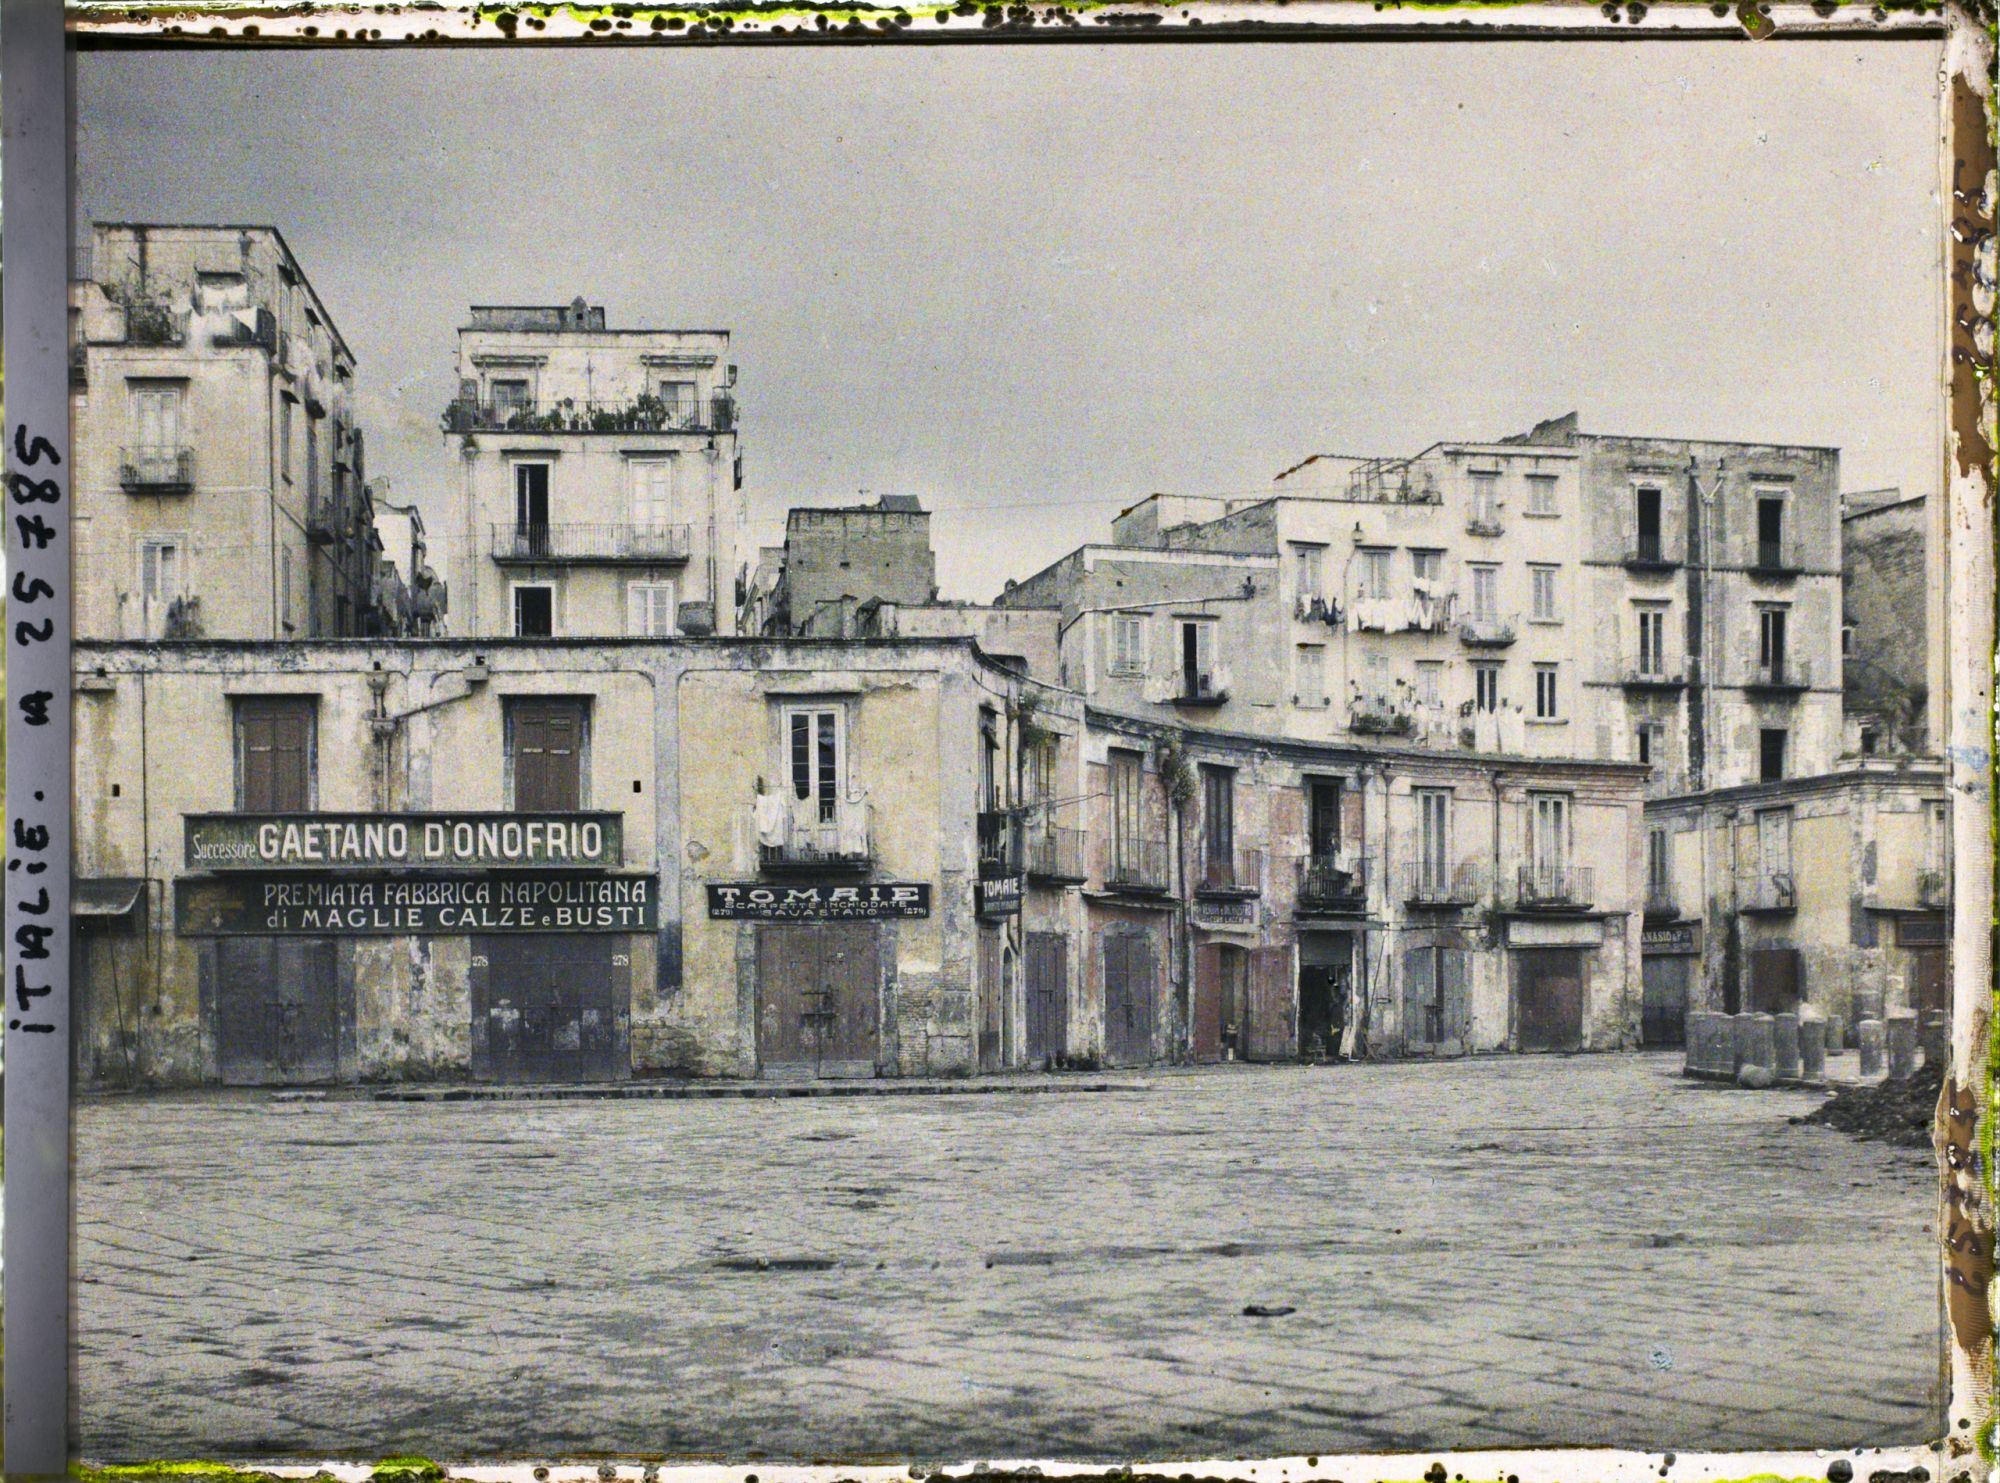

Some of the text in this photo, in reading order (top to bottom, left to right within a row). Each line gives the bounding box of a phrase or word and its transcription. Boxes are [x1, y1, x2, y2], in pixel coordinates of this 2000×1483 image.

[193, 820, 604, 860] Successore GAETANO D'ONOFRIO
[263, 880, 647, 907] PREMIATA FABBRICA NAPOLITANA
[717, 887, 919, 903] TOMAIE
[983, 877, 1019, 897] TOMAIE
[725, 900, 908, 909] SCARPETTE INCHIODATE
[761, 908, 878, 917] SAVASTANO
[266, 907, 645, 928] di MAGLIE CALZE e BUSTI
[472, 955, 489, 967] 278
[612, 954, 629, 966] 278
